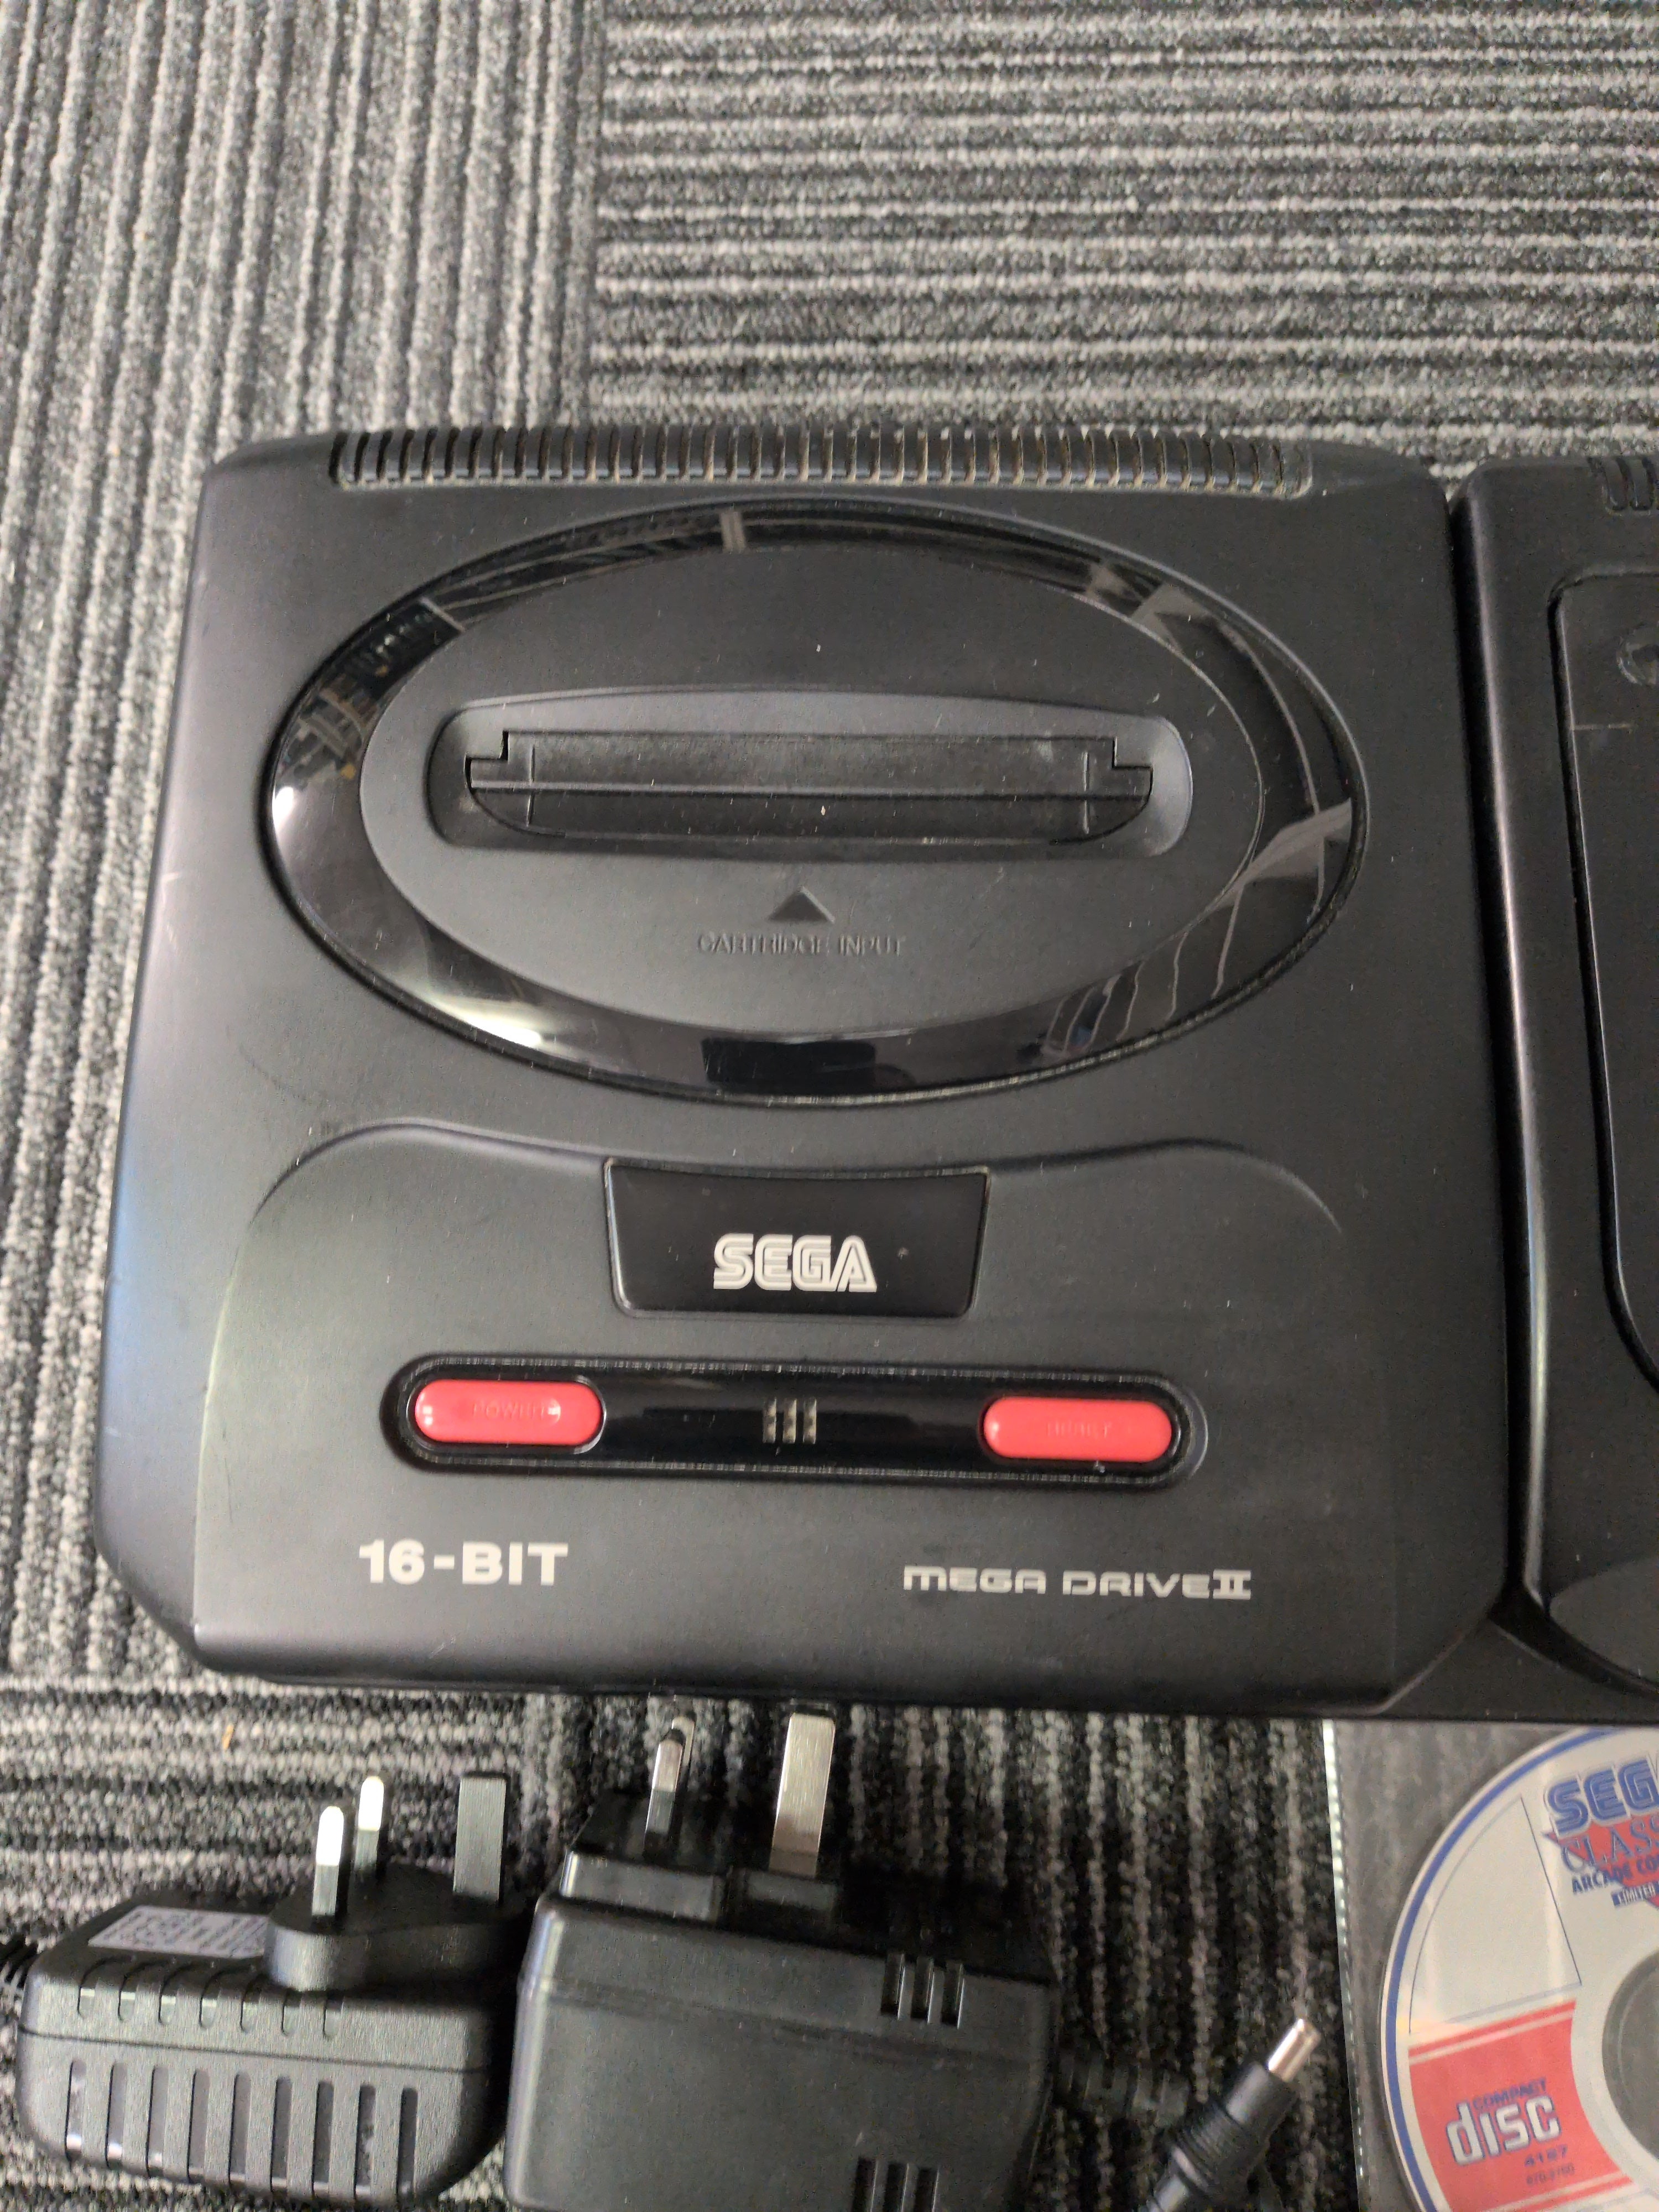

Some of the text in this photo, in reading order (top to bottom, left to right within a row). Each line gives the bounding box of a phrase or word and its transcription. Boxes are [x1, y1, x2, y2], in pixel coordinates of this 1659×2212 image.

[697, 931, 907, 957] CARTRIDGE INPUT
[713, 1233, 877, 1293] SEGA
[359, 1539, 568, 1585] 16-BIT
[903, 1565, 1046, 1594] MEGA
[1545, 1754, 1659, 1837] SEG
[1571, 1862, 1634, 1895] ARCADE
[1445, 2095, 1562, 2167] disc
